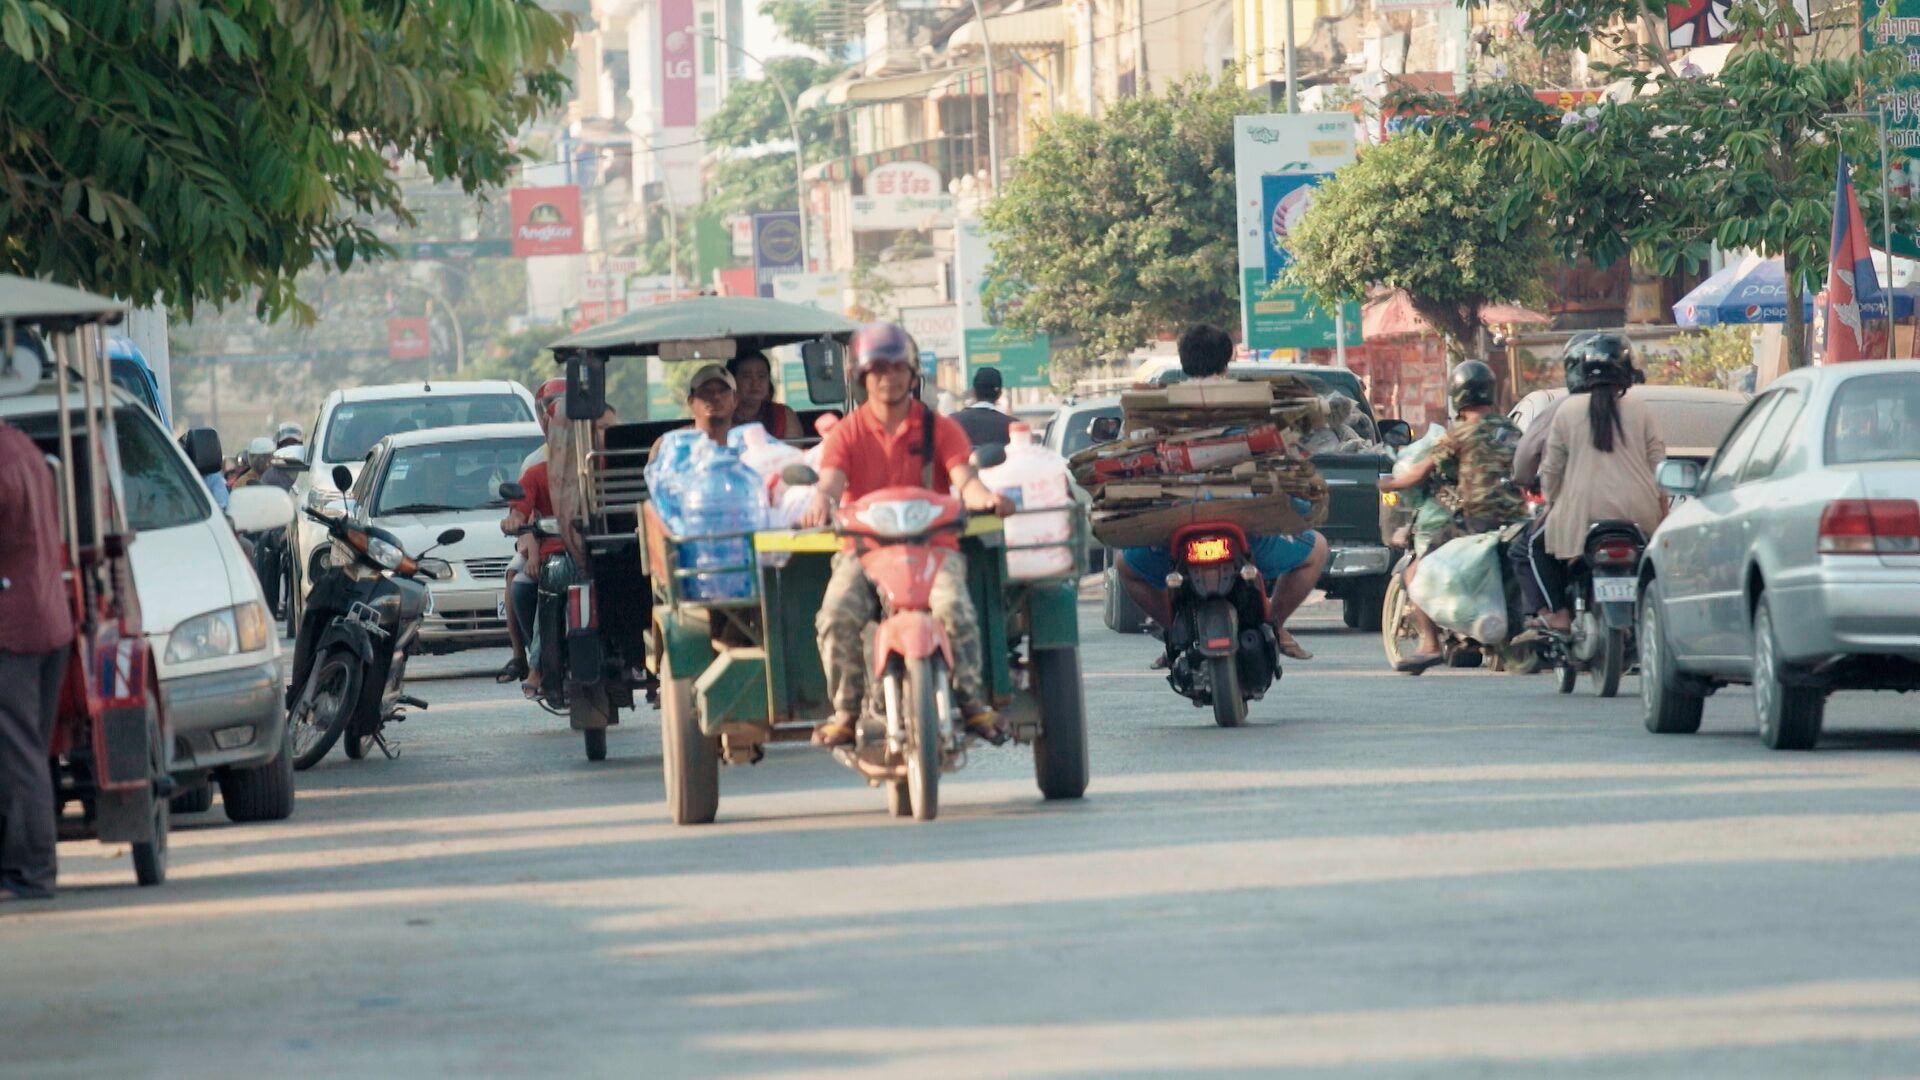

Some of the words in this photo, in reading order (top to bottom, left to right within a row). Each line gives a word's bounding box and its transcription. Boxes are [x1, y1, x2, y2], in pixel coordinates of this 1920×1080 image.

[665, 61, 692, 79] LG
[1741, 284, 1787, 298] pep
[1763, 307, 1788, 318] pep
